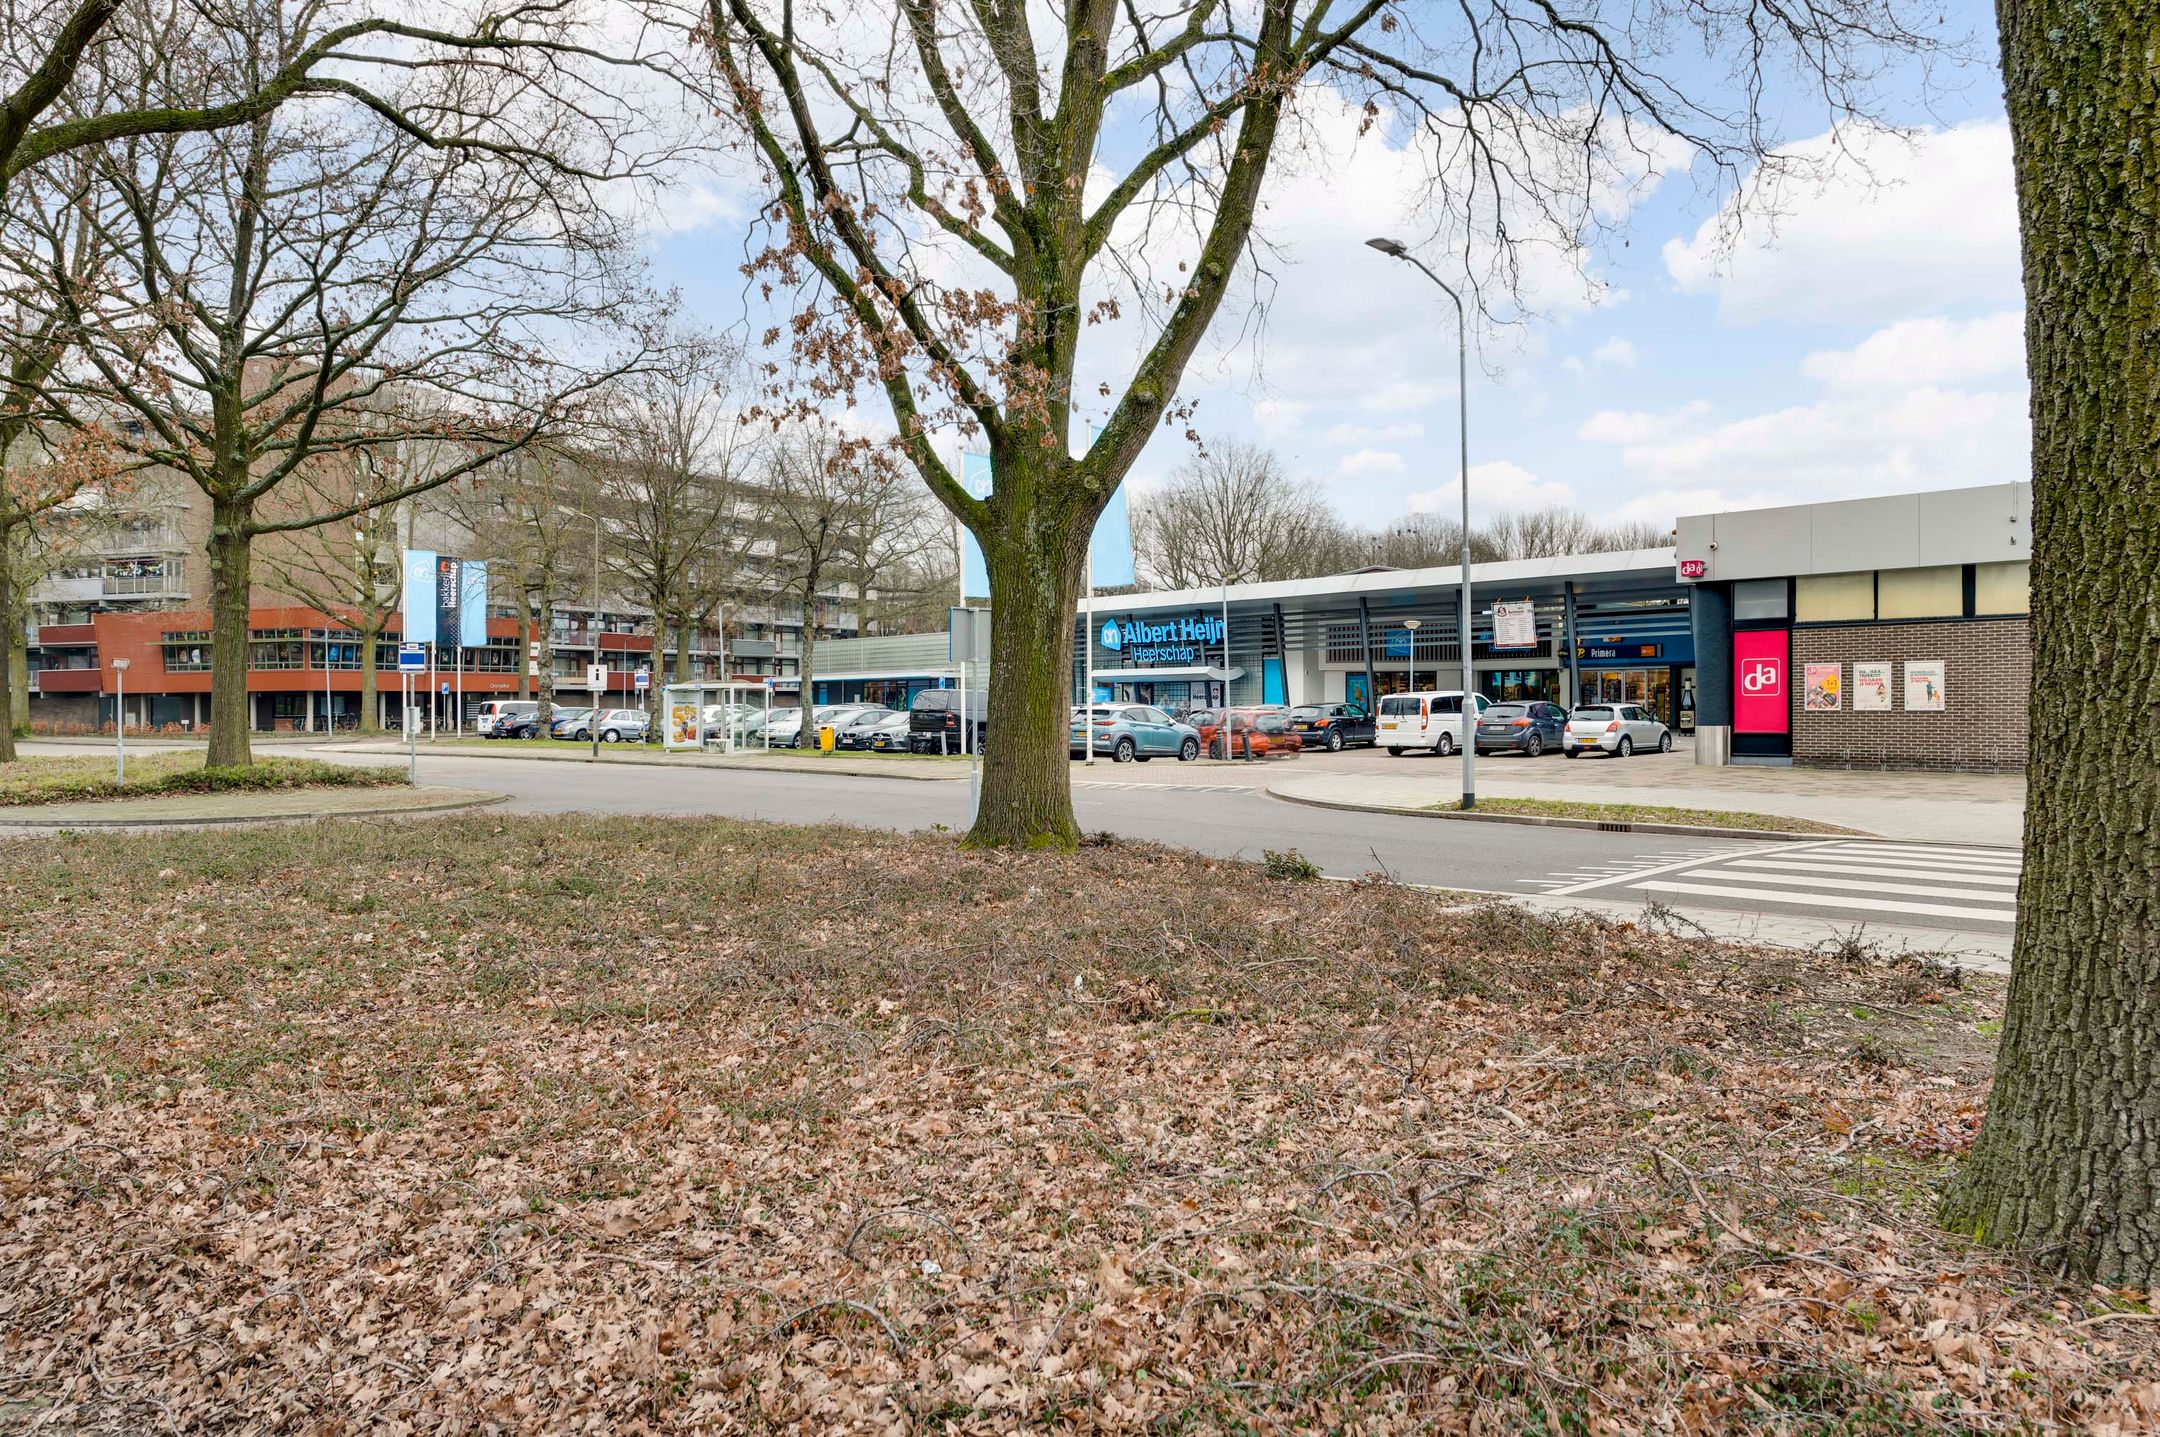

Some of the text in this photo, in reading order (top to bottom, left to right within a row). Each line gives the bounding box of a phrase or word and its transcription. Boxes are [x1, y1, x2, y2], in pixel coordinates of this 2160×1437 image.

[441, 572, 451, 608] bakkerij
[449, 562, 459, 608] Heerschap
[1122, 616, 1225, 645] Albert Heijn
[1133, 645, 1195, 663] Heerschap
[1591, 648, 1616, 658] Primera
[1744, 664, 1777, 691] da
